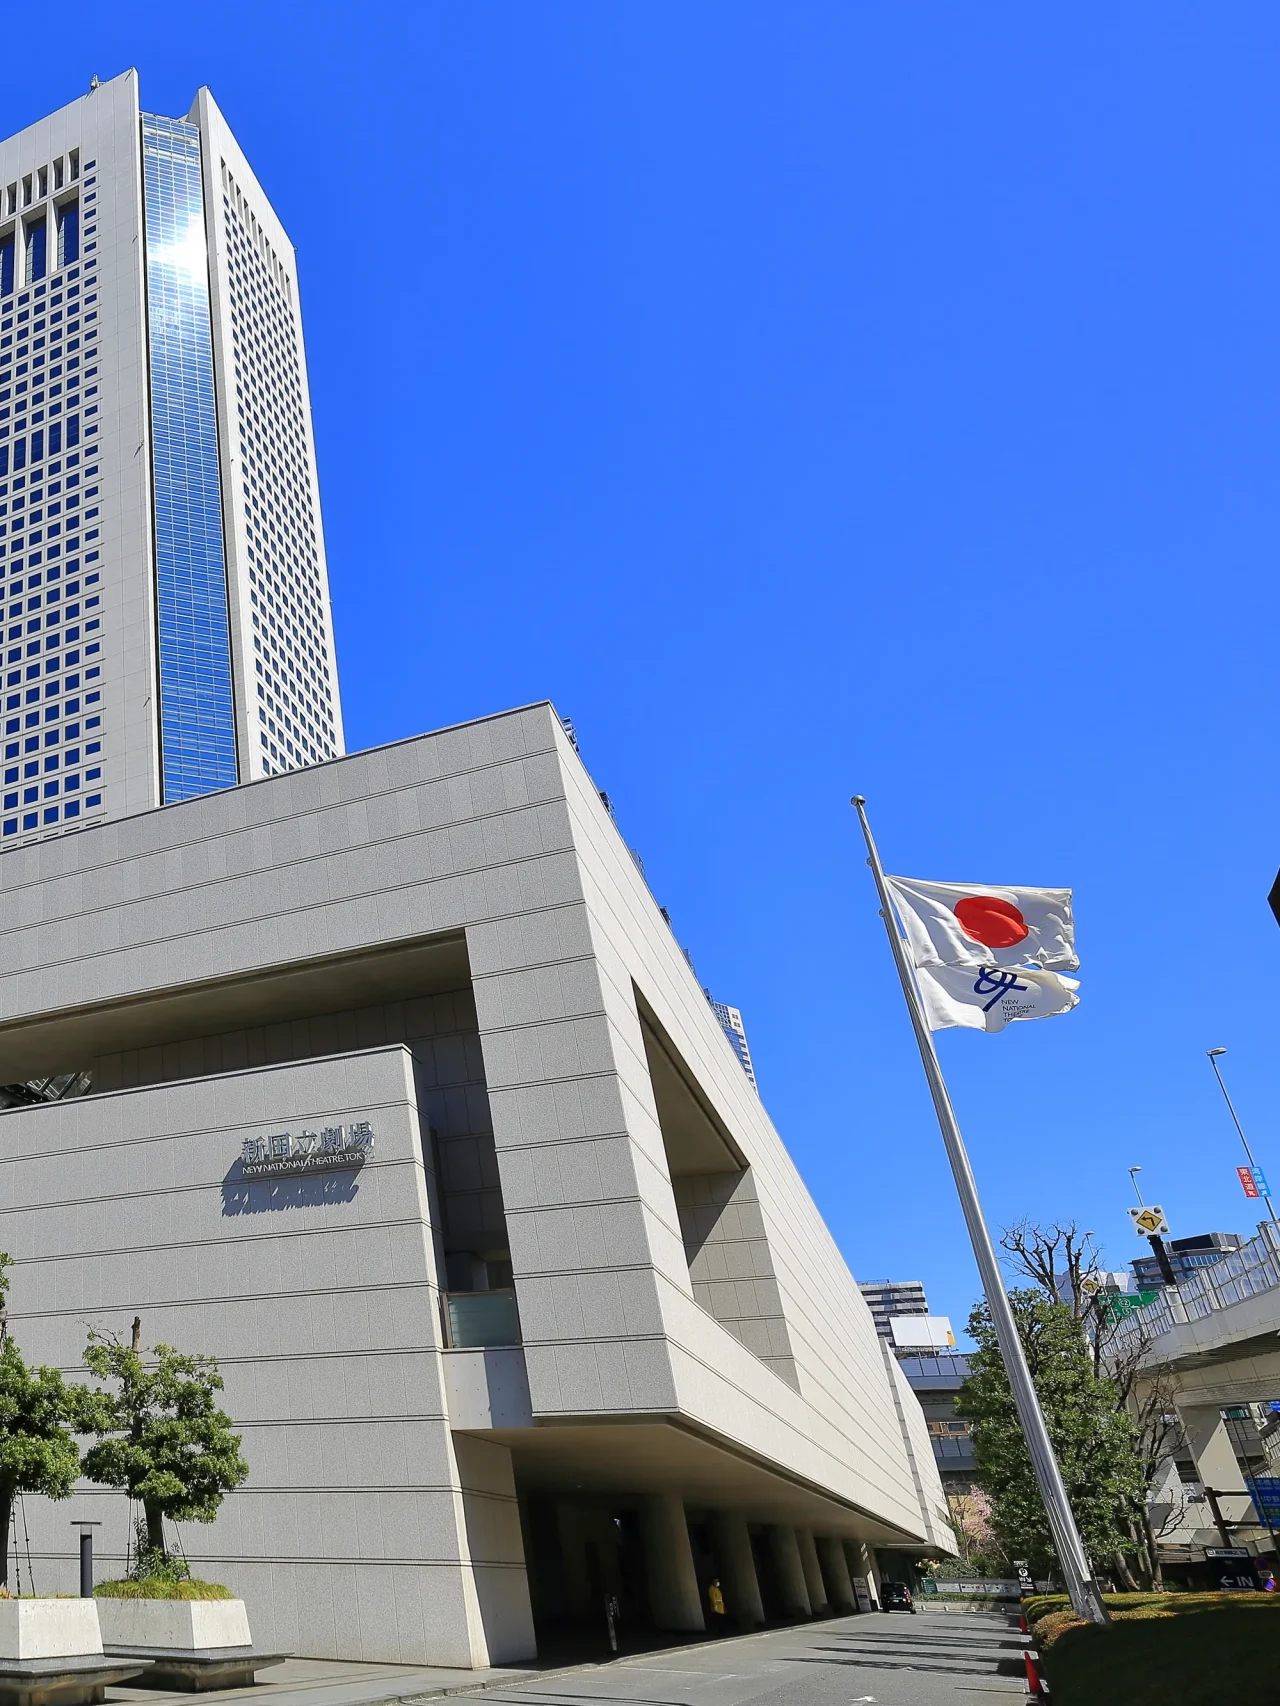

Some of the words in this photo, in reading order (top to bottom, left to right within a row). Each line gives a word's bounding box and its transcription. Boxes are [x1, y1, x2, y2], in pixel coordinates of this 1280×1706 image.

[241, 1121, 375, 1164] 新国立劇場
[242, 1165, 262, 1175] NEW
[263, 1159, 305, 1172] NATIONAL
[344, 1151, 375, 1161] TOKYO
[1236, 1576, 1254, 1587] IN
